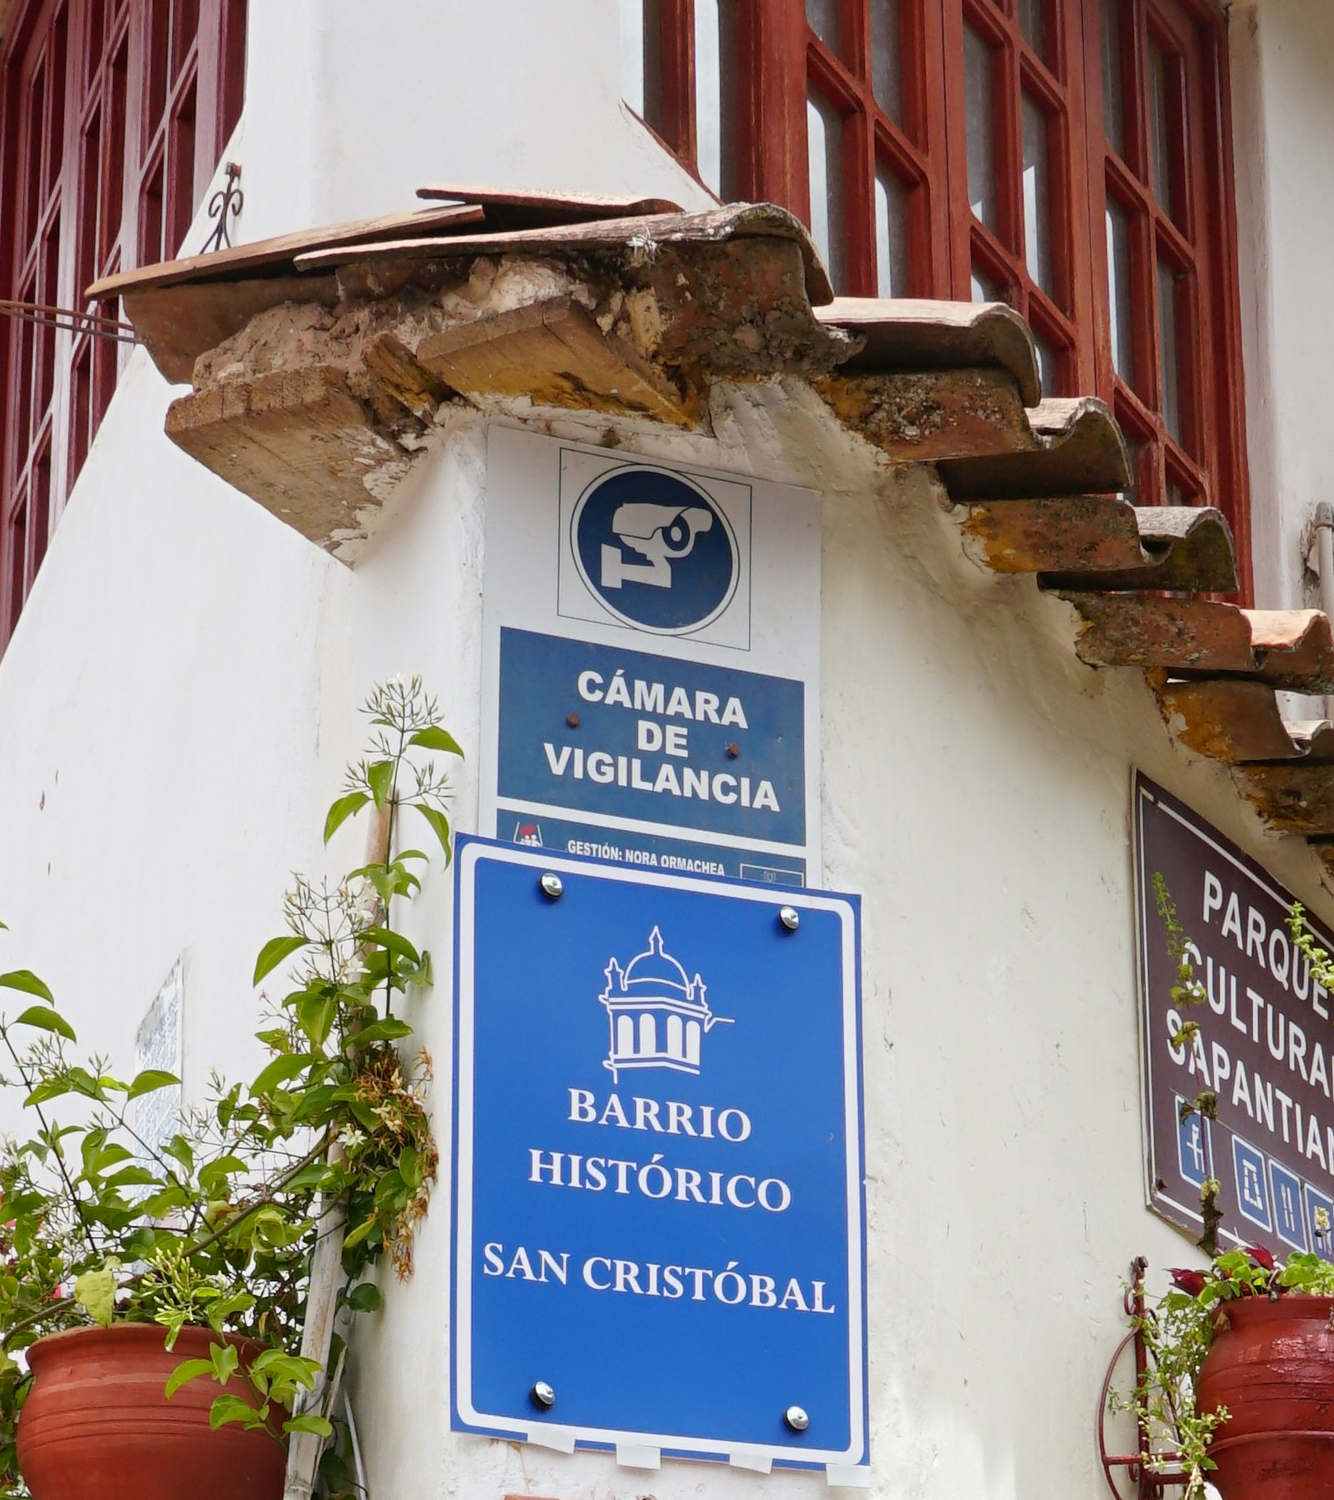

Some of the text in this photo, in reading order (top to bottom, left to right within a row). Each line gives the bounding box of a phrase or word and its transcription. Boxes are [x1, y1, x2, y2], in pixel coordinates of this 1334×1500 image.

[577, 669, 748, 729] CÁMARA
[637, 719, 688, 758] DE
[544, 742, 780, 812] VIGILANCIA
[567, 839, 725, 877] GESTIÓN: NORA ORMACHEA
[1203, 870, 1329, 1020] PARQUE
[568, 1088, 752, 1142] BARRIO
[528, 1148, 791, 1212] HISTÓRICO
[483, 1242, 836, 1314] SAN CRISTÓBAL
